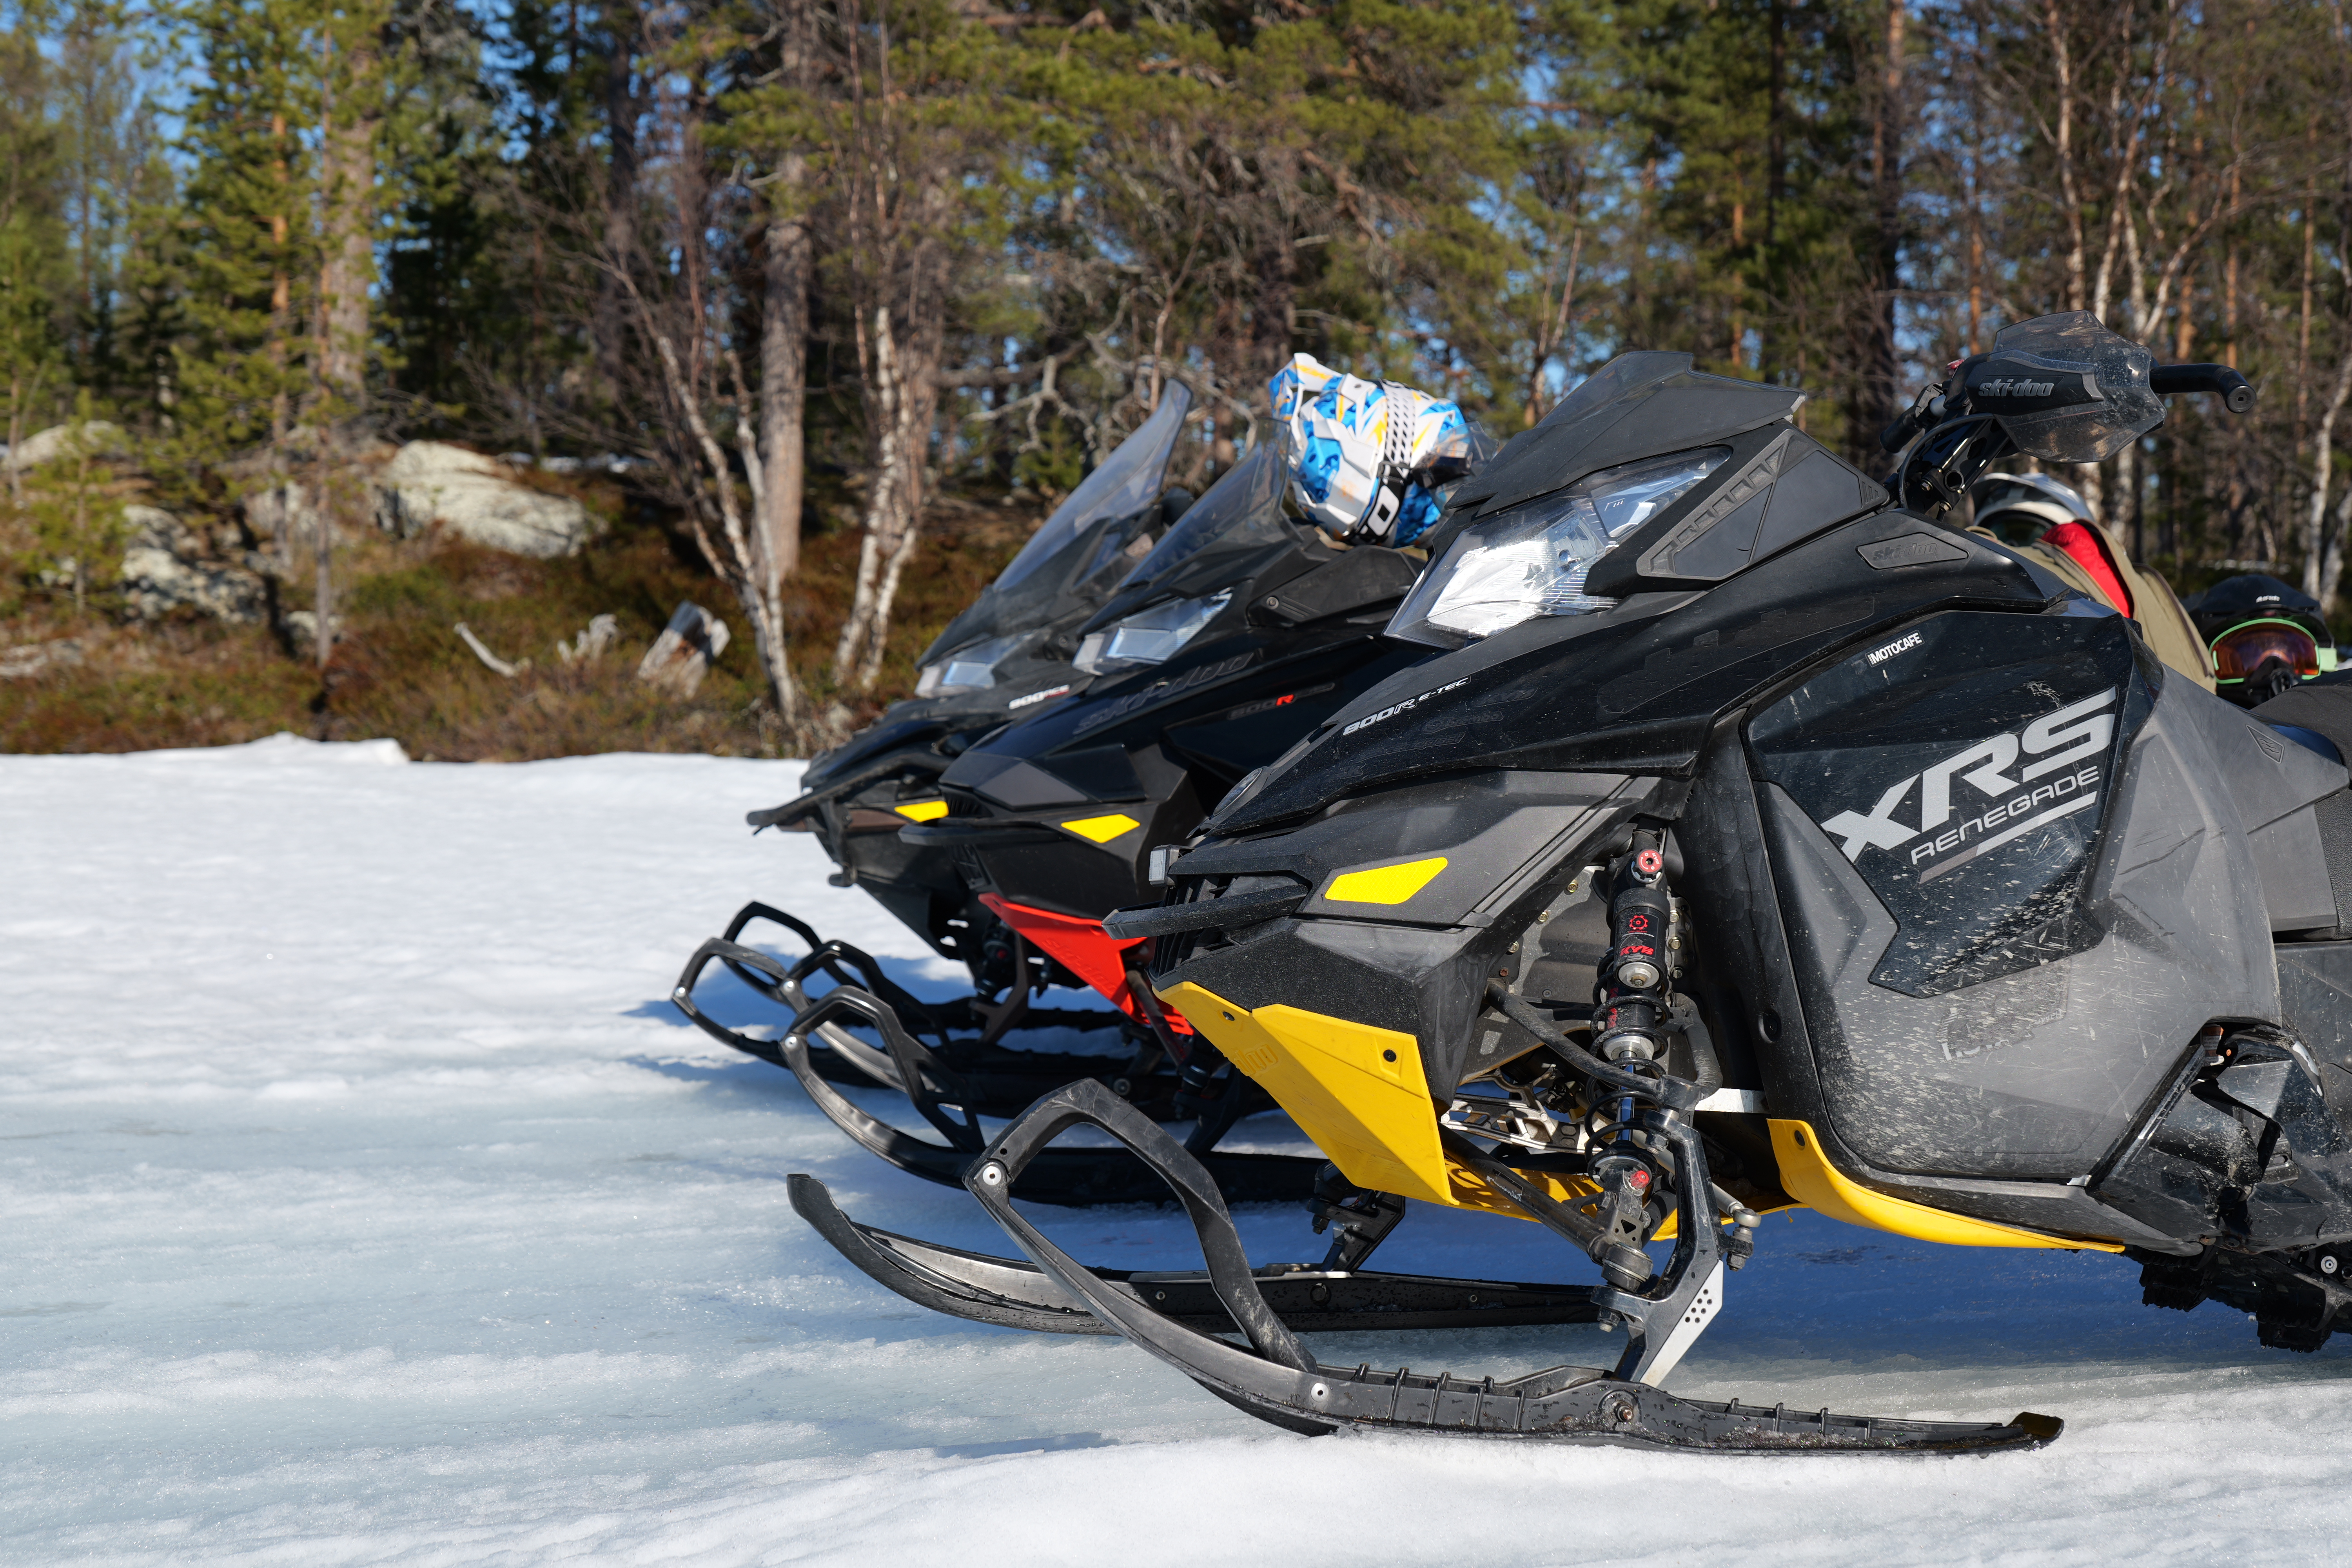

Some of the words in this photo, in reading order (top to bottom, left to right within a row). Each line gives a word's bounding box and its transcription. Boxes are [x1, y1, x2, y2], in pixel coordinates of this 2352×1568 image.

[1978, 379, 2054, 397] ski-doo
[1872, 543, 1937, 561] ski-doo
[1869, 632, 1922, 664] MOTOCAFE
[1342, 699, 1416, 736] 800R
[1418, 677, 1469, 701] E-TEC
[1820, 686, 2116, 864] XRS
[1911, 766, 2100, 865] RENEGADE
